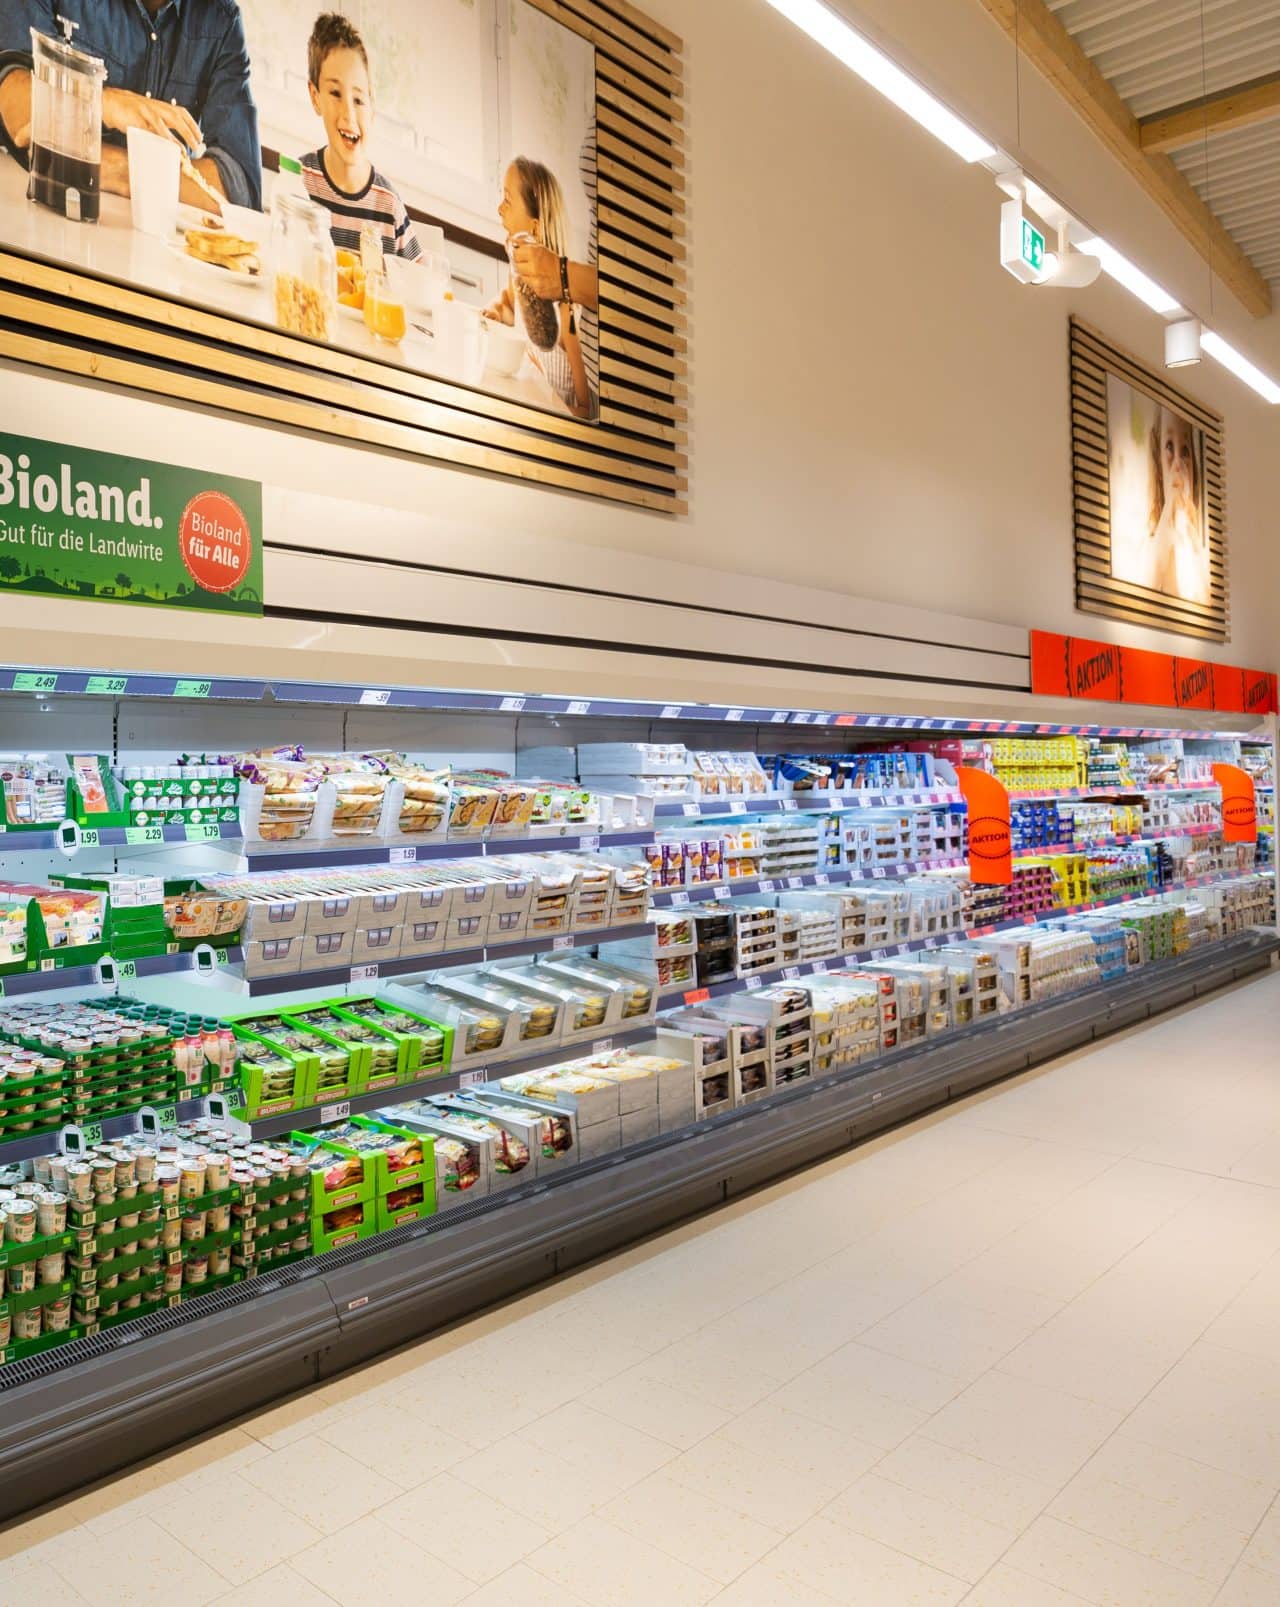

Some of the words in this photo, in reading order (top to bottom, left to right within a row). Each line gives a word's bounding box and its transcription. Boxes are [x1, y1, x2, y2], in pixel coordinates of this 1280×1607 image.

[192, 511, 242, 546] Bioland
[31, 524, 54, 548] für
[59, 529, 83, 551] die
[89, 533, 163, 561] Landwirte
[189, 537, 210, 559] für
[212, 545, 240, 568] Alle
[1077, 648, 1114, 692] AKTION
[35, 677, 55, 688] 2.49
[106, 680, 125, 691] 3.29
[1181, 668, 1208, 703] AKTION
[81, 831, 97, 843] 1.99
[145, 829, 162, 840] 2.29
[203, 826, 218, 838] 1.79
[972, 832, 1008, 844] AKTION
[119, 964, 134, 975] -.49
[160, 1109, 175, 1122] -.99
[84, 1126, 101, 1140] -.35
